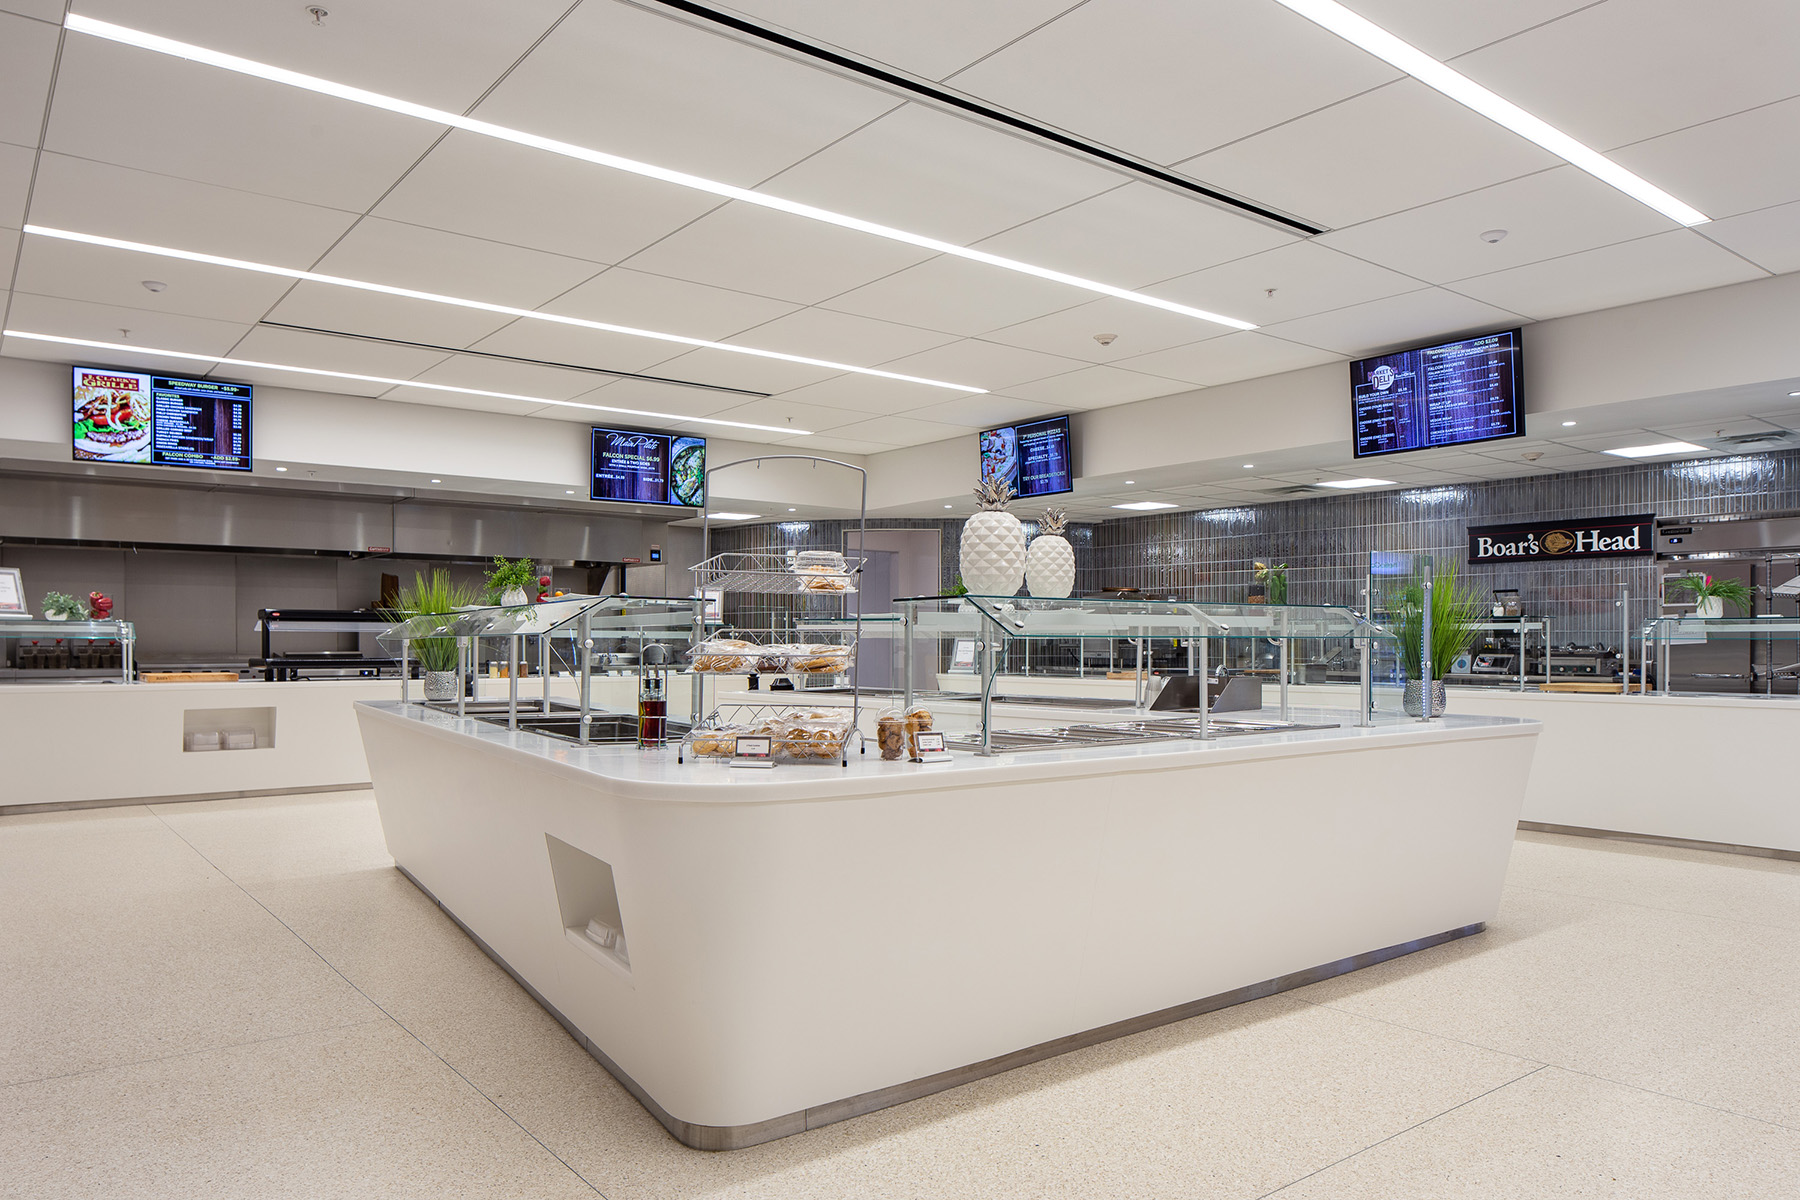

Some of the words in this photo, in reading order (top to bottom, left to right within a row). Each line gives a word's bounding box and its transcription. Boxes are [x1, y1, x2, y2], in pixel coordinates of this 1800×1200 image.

[83, 379, 138, 390] GRILLE
[1372, 375, 1390, 390] DELI
[606, 433, 634, 448] Main
[628, 435, 660, 450] Plate
[1477, 533, 1539, 558] Boar's
[1575, 526, 1640, 552] Head
